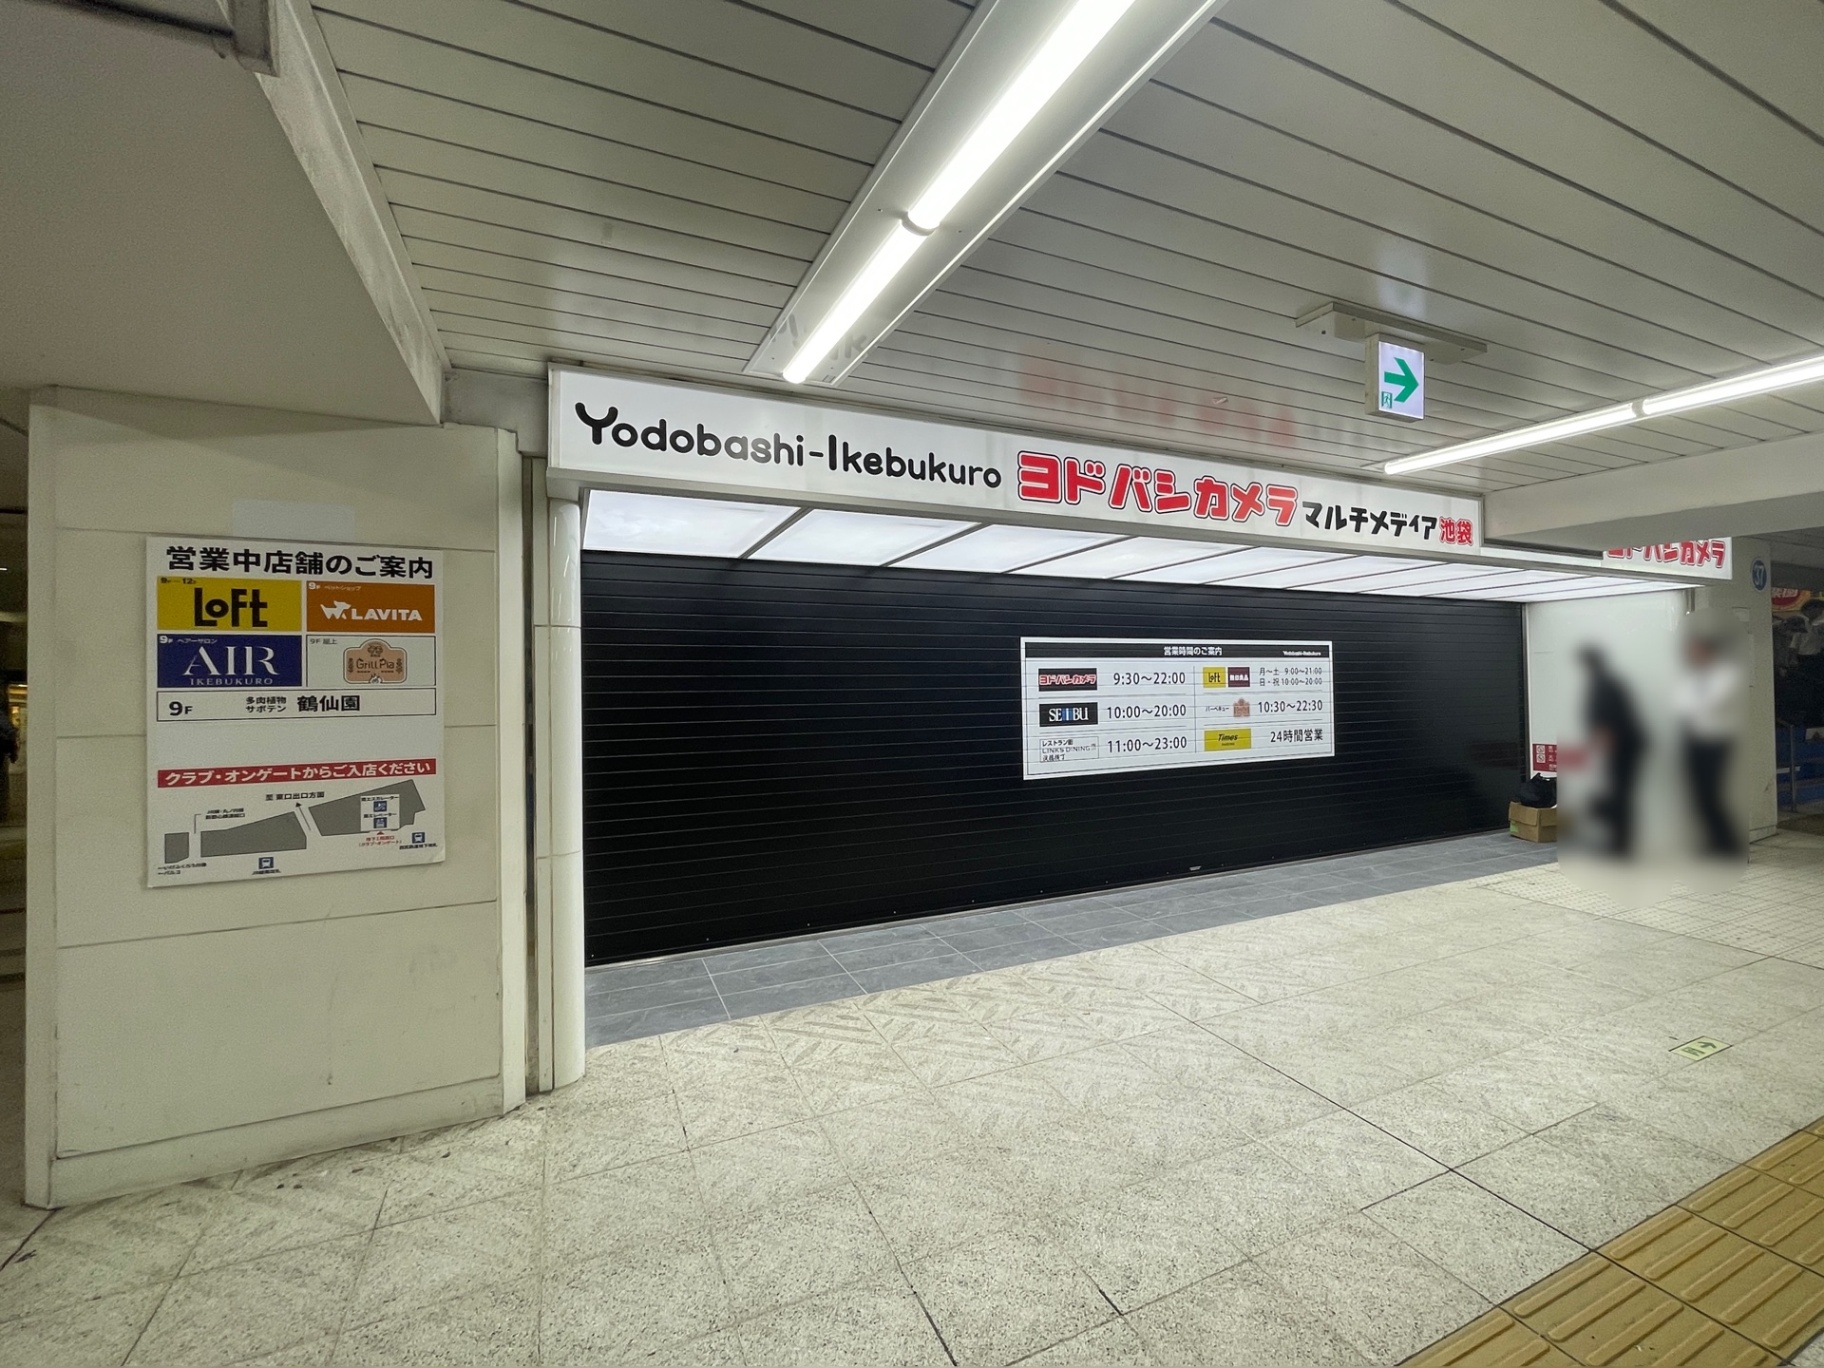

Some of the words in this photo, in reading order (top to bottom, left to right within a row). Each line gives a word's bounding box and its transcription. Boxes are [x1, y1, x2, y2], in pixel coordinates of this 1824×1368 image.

[575, 402, 1002, 488] Yodobashi-Ikebukuro
[1017, 450, 1299, 526] ヨドバシカメラ
[1302, 500, 1437, 540] マルチメディア
[1439, 516, 1474, 546] 池袋
[166, 545, 434, 580] 営業中店舗のご案内
[1754, 565, 1764, 585] 37
[351, 608, 423, 621] LAVITA
[160, 635, 173, 644] 9F
[1163, 646, 1222, 656] 営業時間のご案内
[182, 645, 280, 676] AIR
[356, 657, 378, 670] Grill
[379, 657, 394, 669] Pia
[190, 678, 273, 686] IKEBUKURO
[1039, 674, 1097, 686] ヨドバシカメラ
[246, 696, 288, 705] 多肉植物
[297, 695, 360, 712] 鶴仙園
[169, 701, 193, 716] 9F
[1048, 707, 1089, 722] SEIBU
[1218, 733, 1238, 741] Times
[1270, 728, 1323, 743] 24時間営業
[165, 761, 432, 787] クラブ・オンゲートからご入店ください
